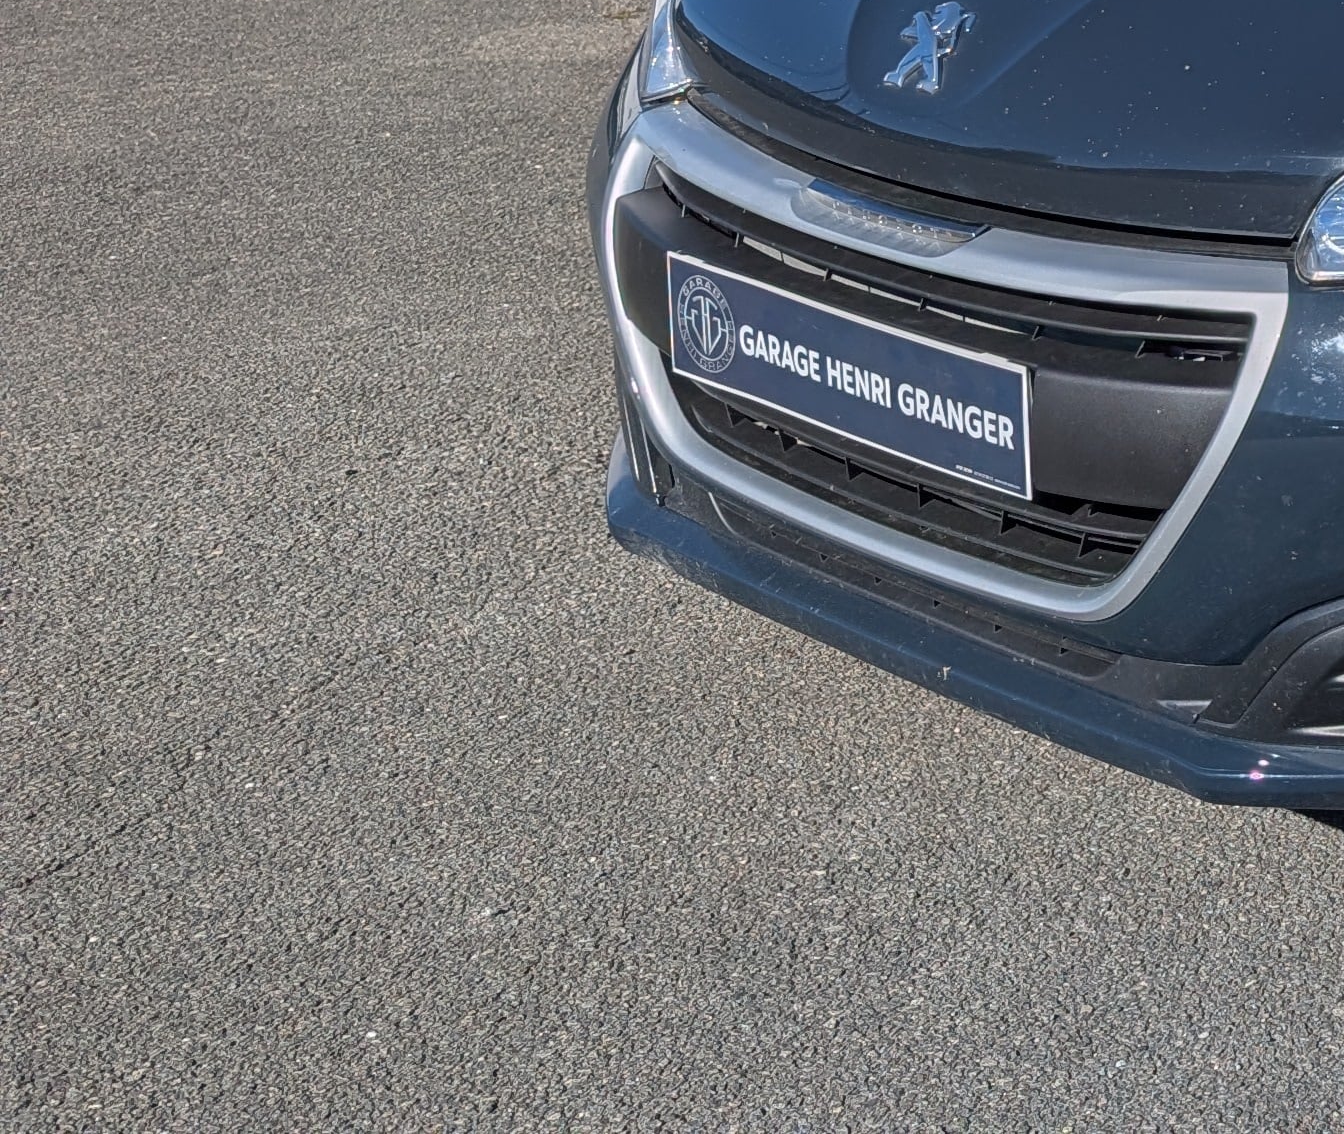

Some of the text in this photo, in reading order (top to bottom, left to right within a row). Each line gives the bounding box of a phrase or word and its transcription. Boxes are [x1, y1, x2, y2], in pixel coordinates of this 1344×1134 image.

[739, 325, 1015, 450] GARAGE HENRI GRANGER
